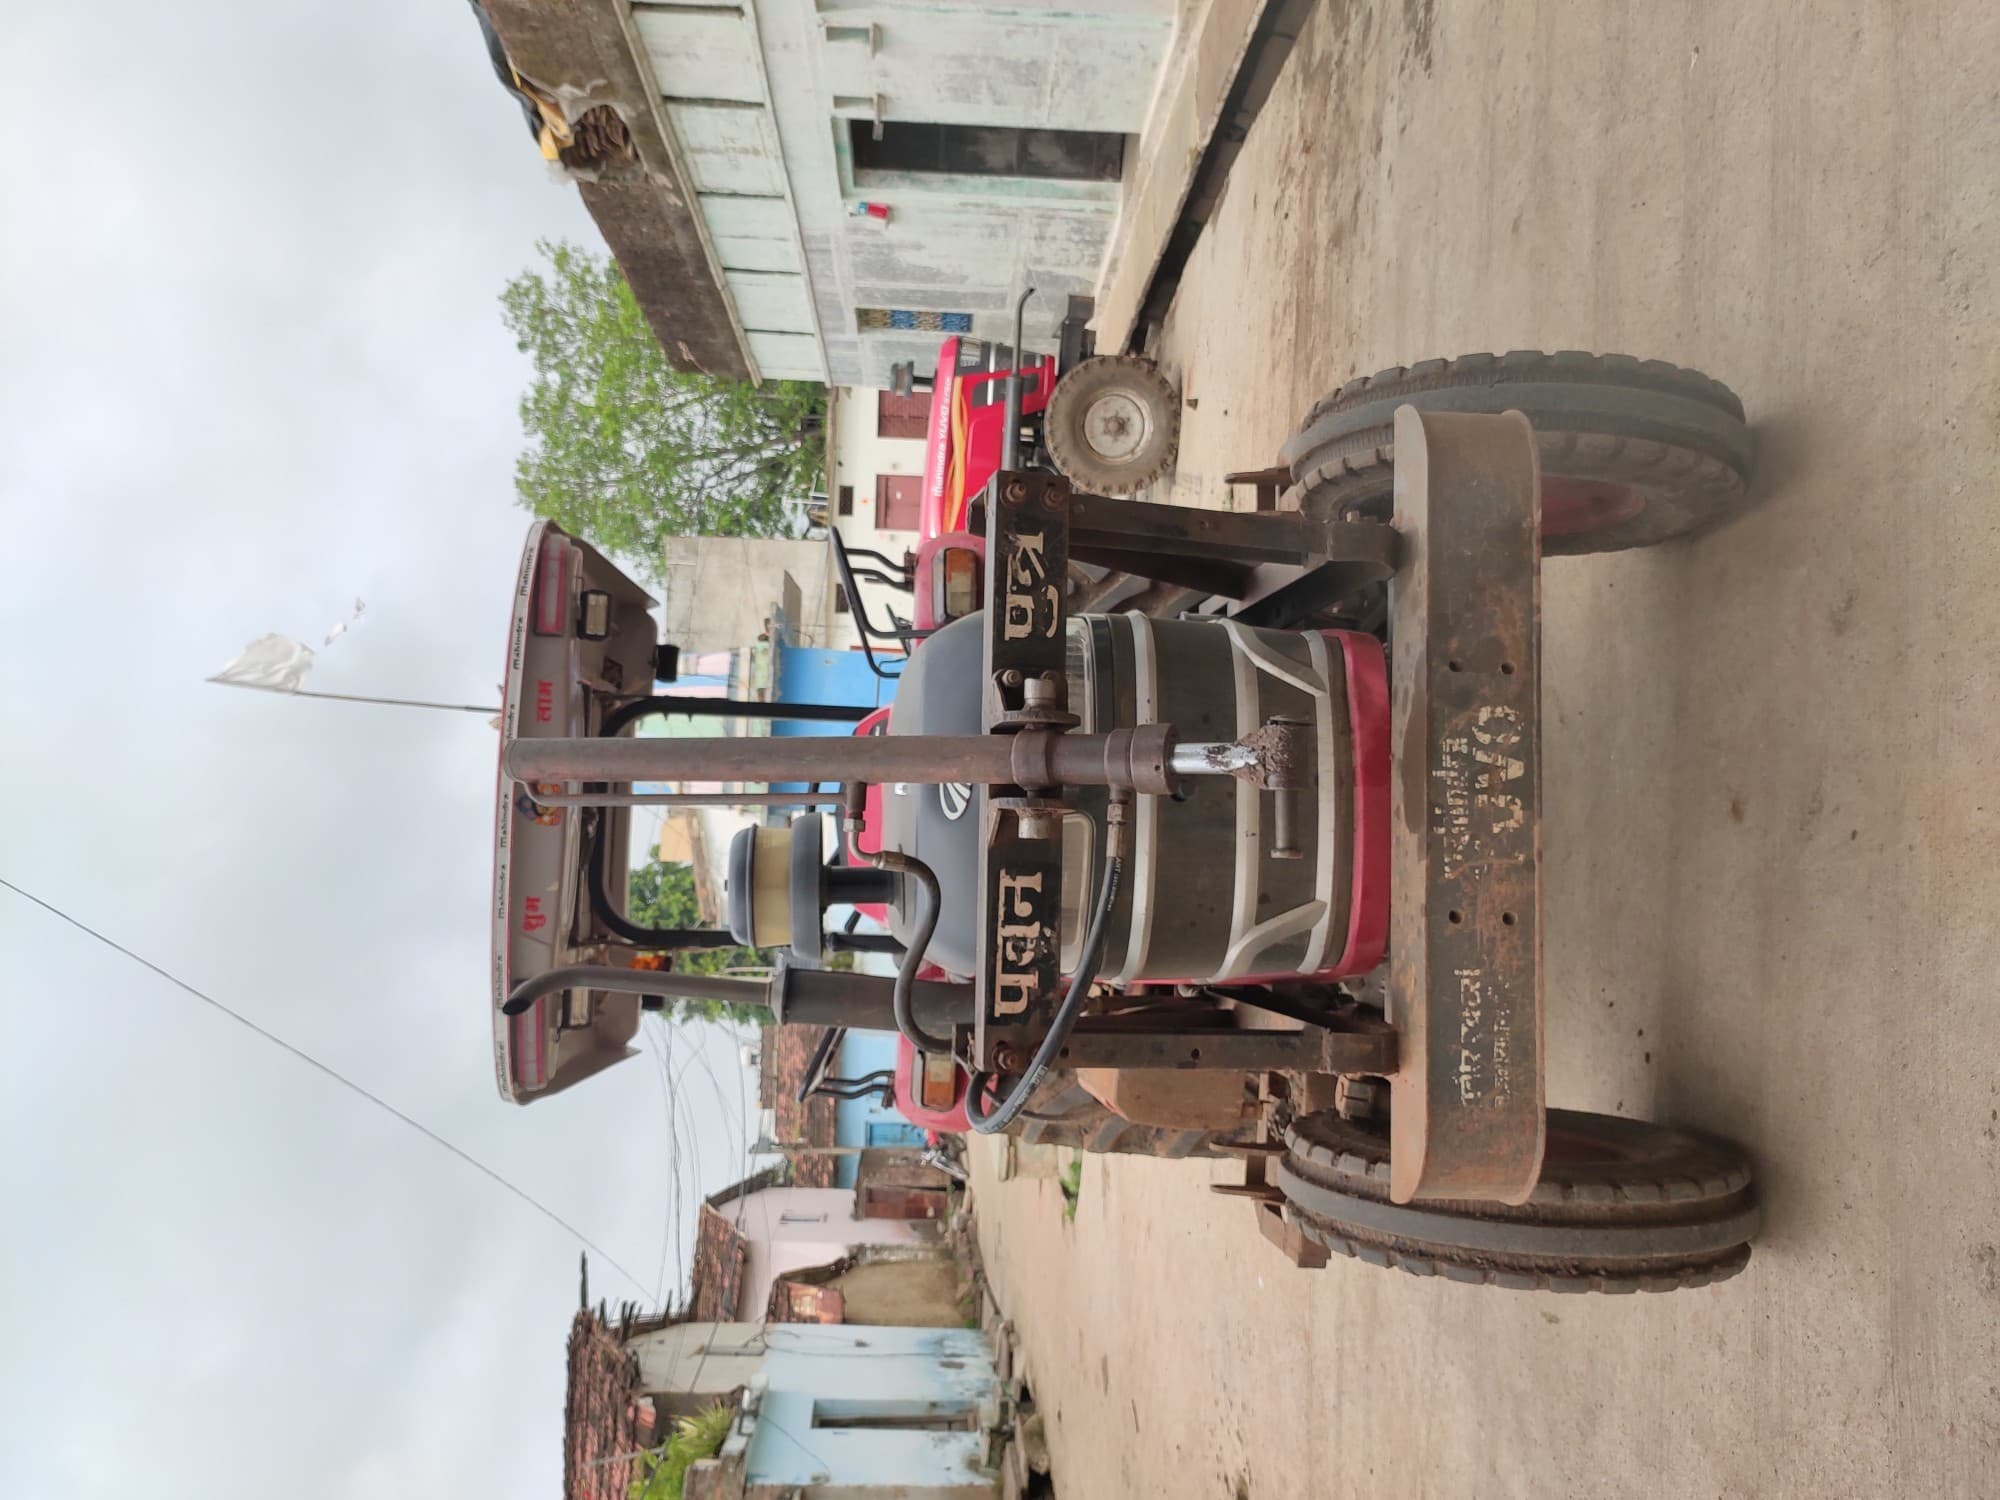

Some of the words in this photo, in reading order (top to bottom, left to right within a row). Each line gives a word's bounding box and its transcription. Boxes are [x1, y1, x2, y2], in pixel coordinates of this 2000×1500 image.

[1004, 531, 1058, 641] पुत्र
[535, 680, 553, 722] लाभ
[505, 703, 516, 739] hindra
[522, 896, 546, 931] शुभ
